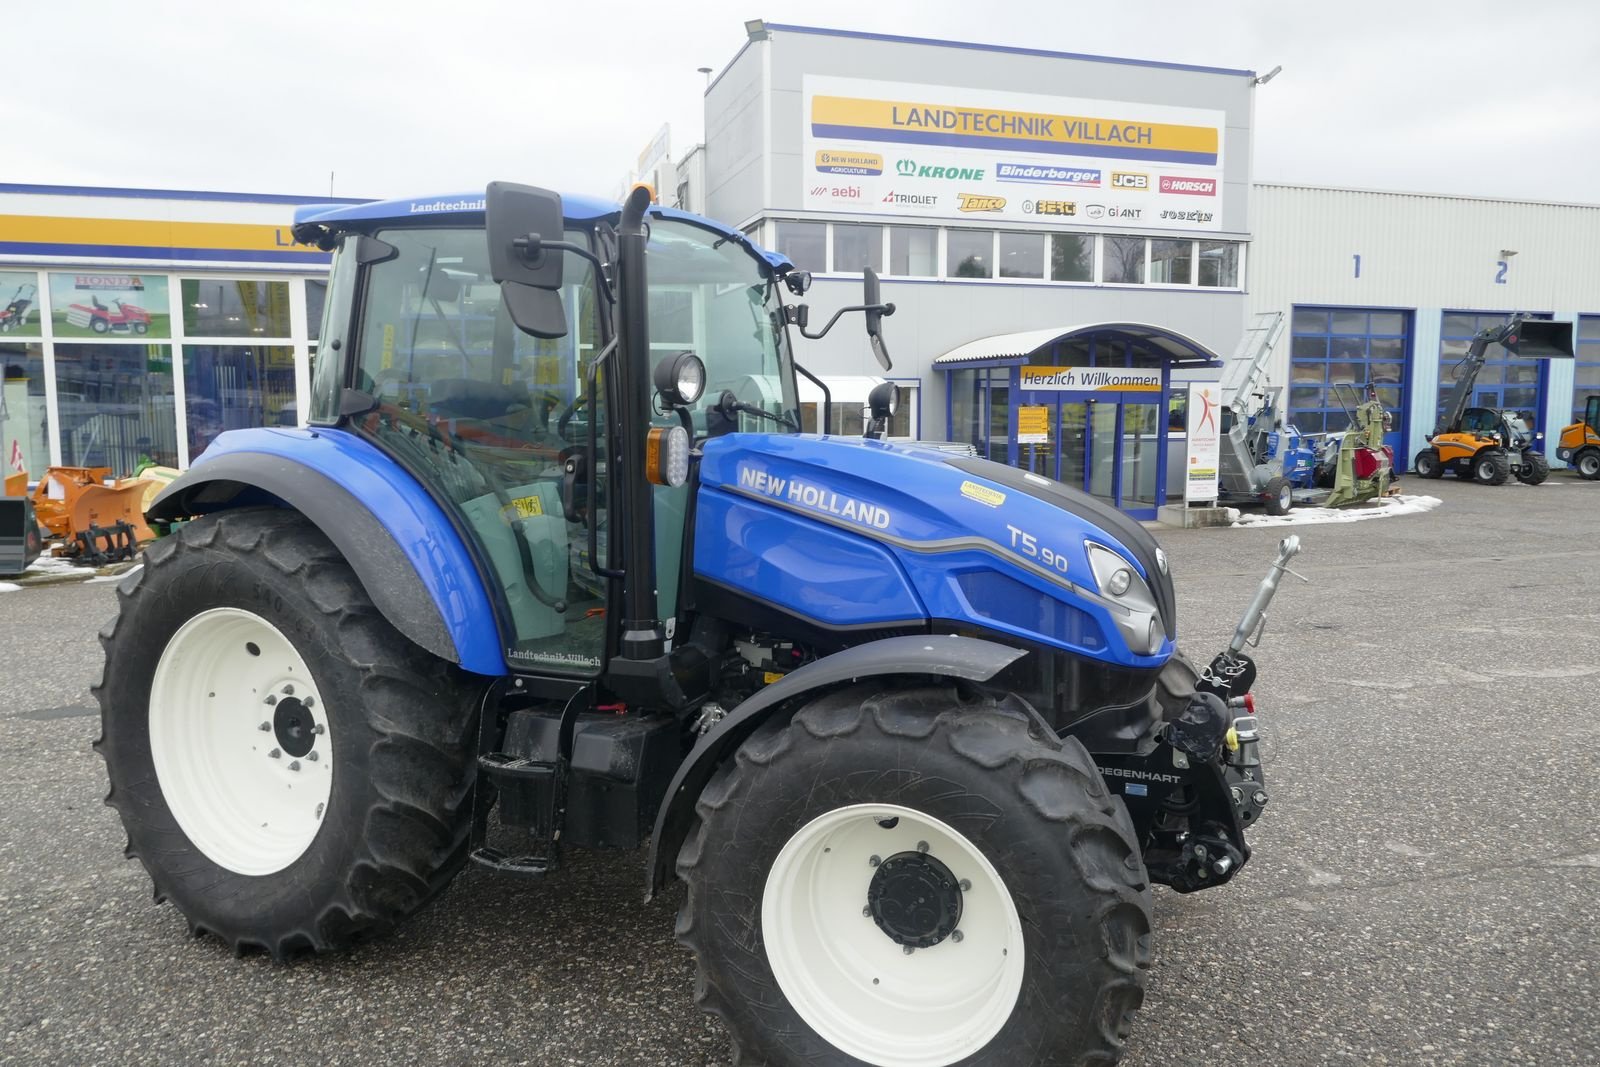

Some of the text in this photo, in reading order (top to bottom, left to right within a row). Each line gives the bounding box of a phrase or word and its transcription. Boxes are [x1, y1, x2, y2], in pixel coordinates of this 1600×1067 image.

[892, 106, 1153, 145] LANDTECHNIK VILLACH
[831, 156, 878, 166] NEW HOLLAND
[830, 166, 868, 175] AGRICULTURE
[918, 166, 985, 181] KRONE
[1000, 165, 1099, 182] Binderberger
[1113, 174, 1147, 188] JCB
[1171, 180, 1214, 193] HORSCH
[831, 186, 861, 199] aebi
[894, 194, 938, 206] TRIOLIET
[957, 193, 1007, 213] Tanco
[1160, 209, 1214, 223] JOSKIN
[1352, 254, 1361, 278] 1
[1495, 260, 1508, 284] 2
[75, 276, 143, 285] HONDA
[1024, 372, 1159, 387] Herzlich Willkommen
[741, 467, 890, 529] NEW HOLLAND
[1006, 524, 1068, 573] T5.90
